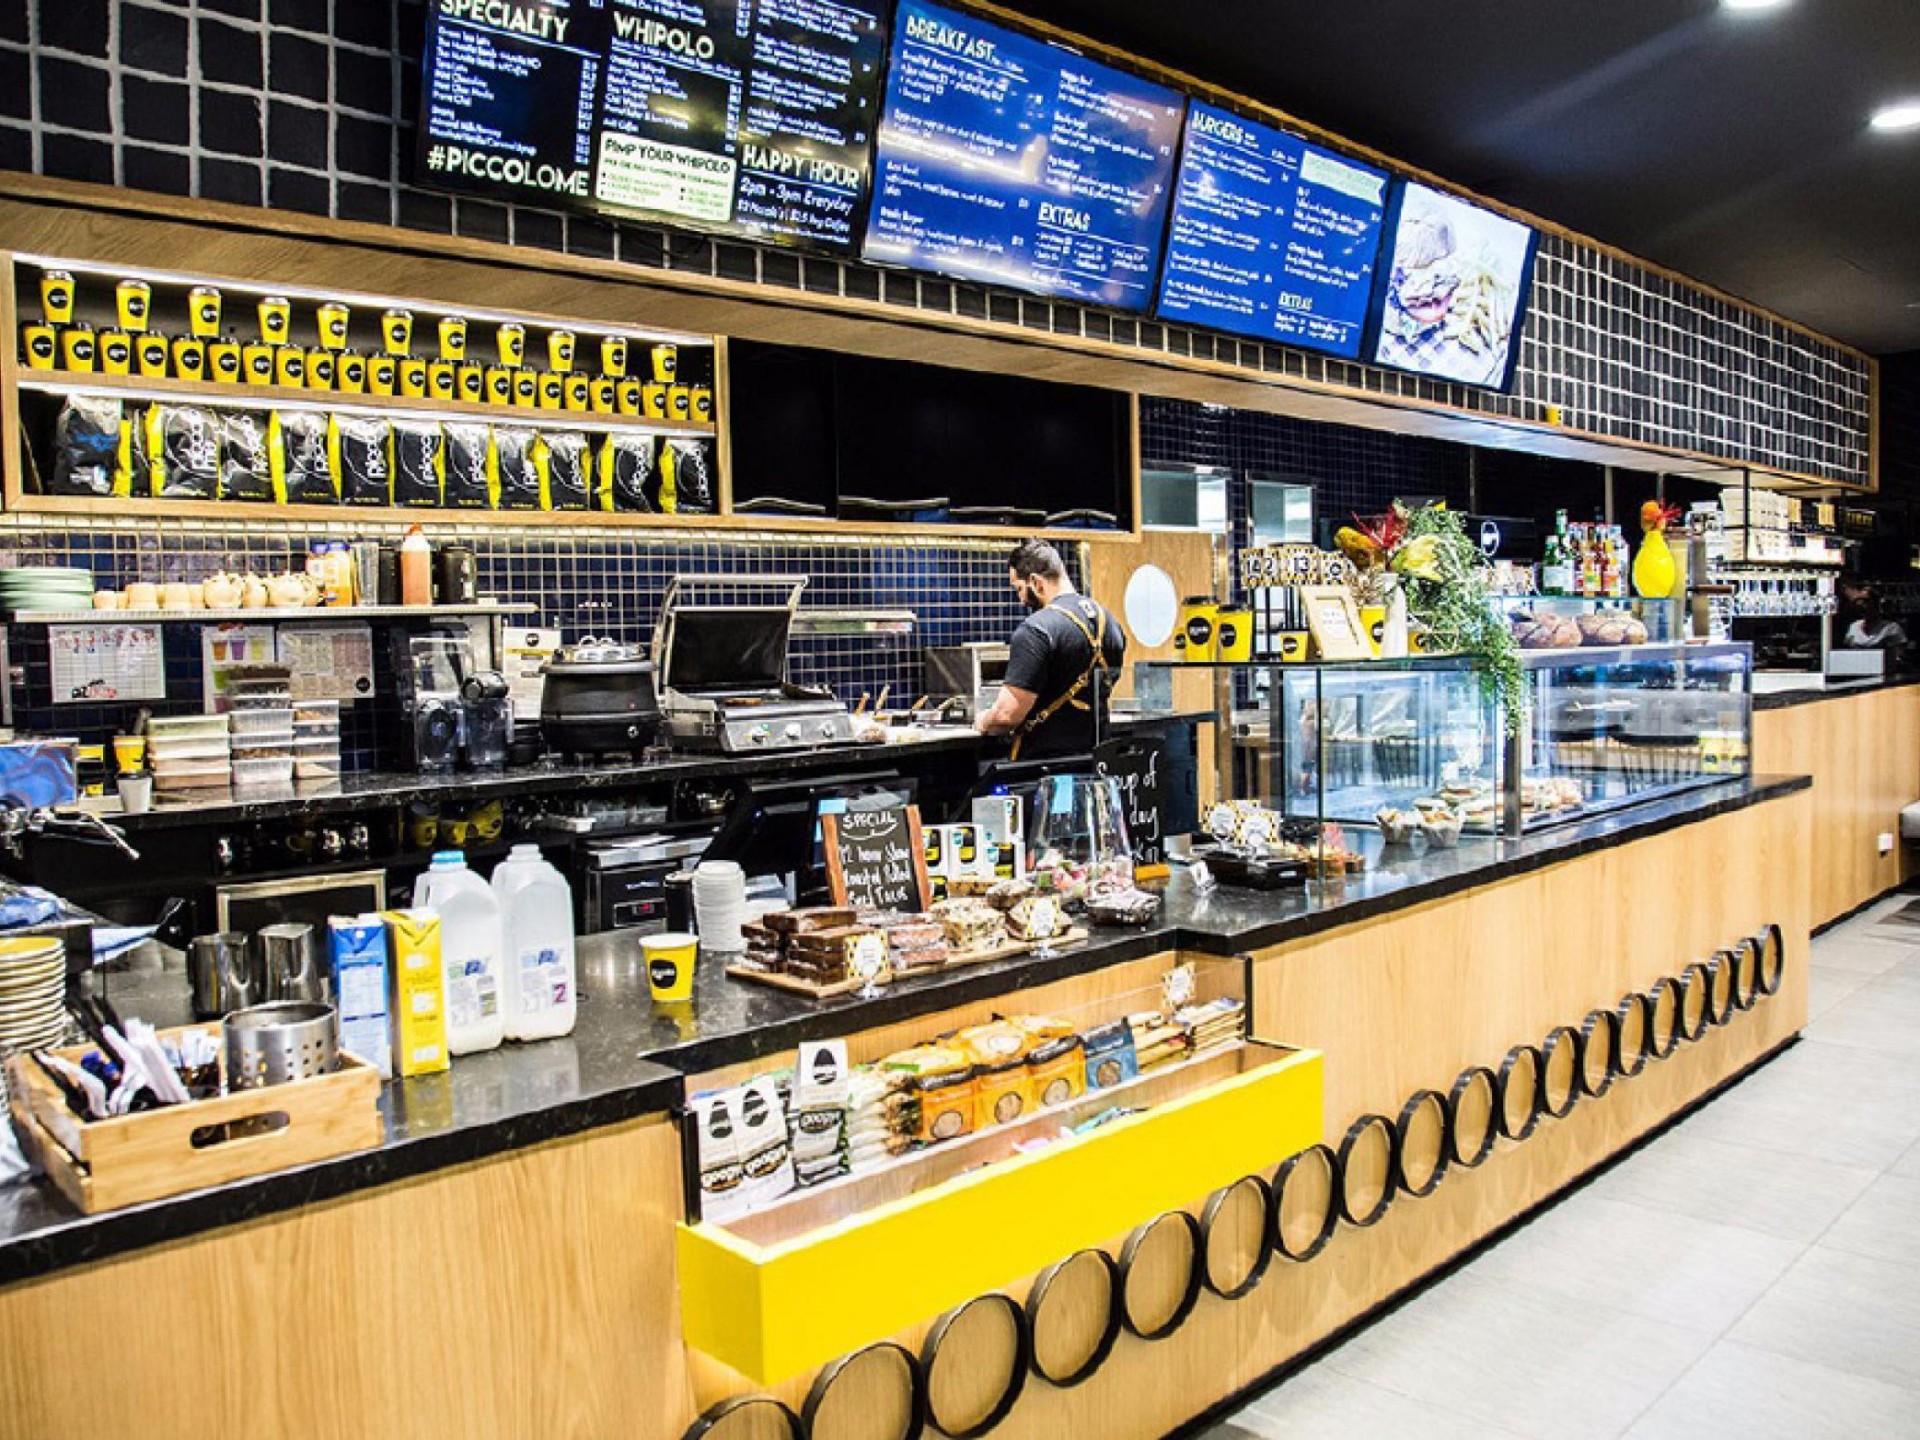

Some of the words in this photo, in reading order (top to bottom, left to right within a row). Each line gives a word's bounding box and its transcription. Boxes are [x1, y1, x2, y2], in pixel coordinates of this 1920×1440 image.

[440, 0, 569, 42] SPECIALTY
[614, 11, 715, 58] WHIPOLO
[905, 15, 997, 60] BREAKFAST
[427, 144, 591, 197] #PICCOLOME
[639, 144, 674, 163] YOUR
[676, 153, 731, 174] WHIPOLO
[742, 143, 804, 177] HAPPY
[809, 160, 860, 190] HOUR
[804, 188, 853, 216] Everyday
[1038, 201, 1091, 231] EXTRAS
[842, 810, 897, 830] SPECIAL
